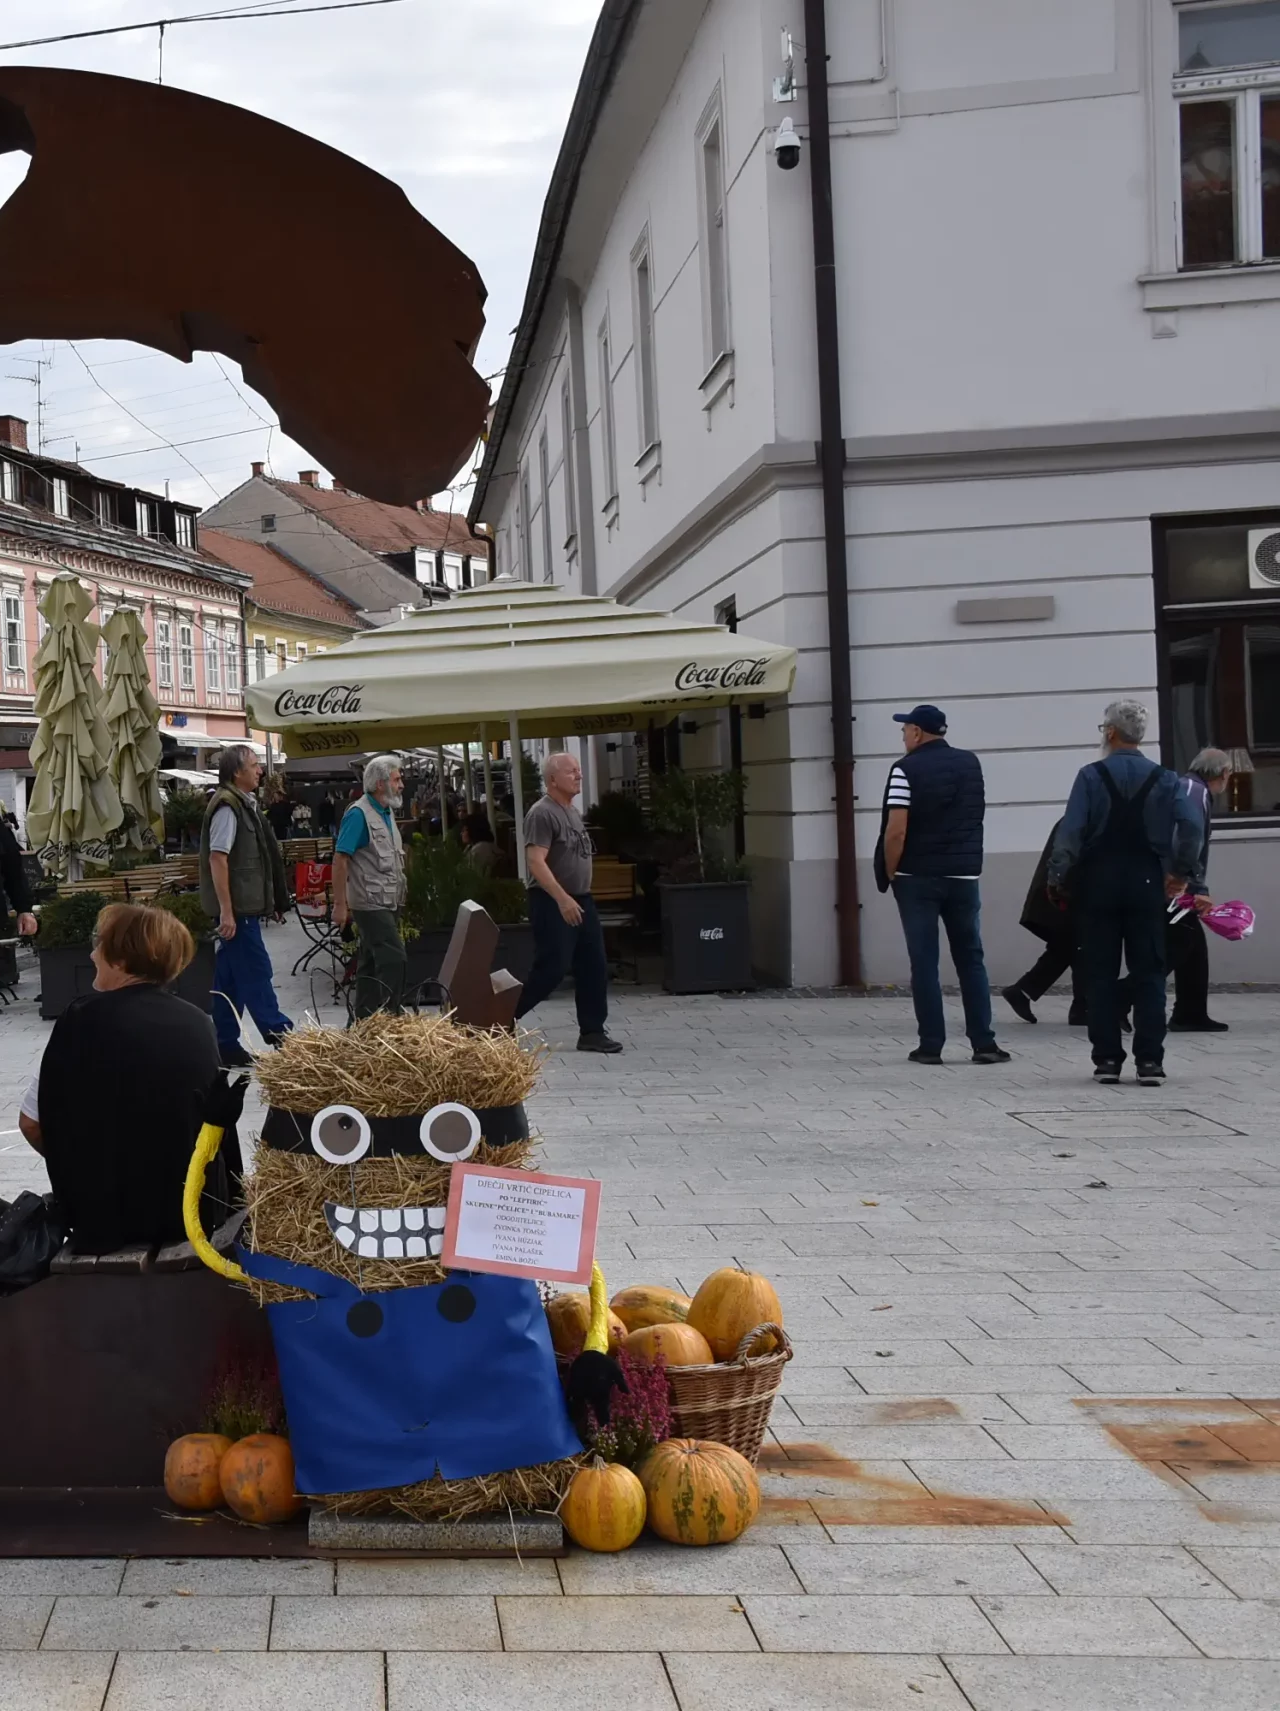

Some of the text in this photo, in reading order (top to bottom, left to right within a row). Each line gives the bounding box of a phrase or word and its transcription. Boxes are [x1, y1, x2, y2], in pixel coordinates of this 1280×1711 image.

[675, 657, 772, 692] Coca-Cola
[274, 684, 365, 717] Coca-Cola
[477, 1179, 572, 1199] DJEČJI VRTIĆ CIPELICA
